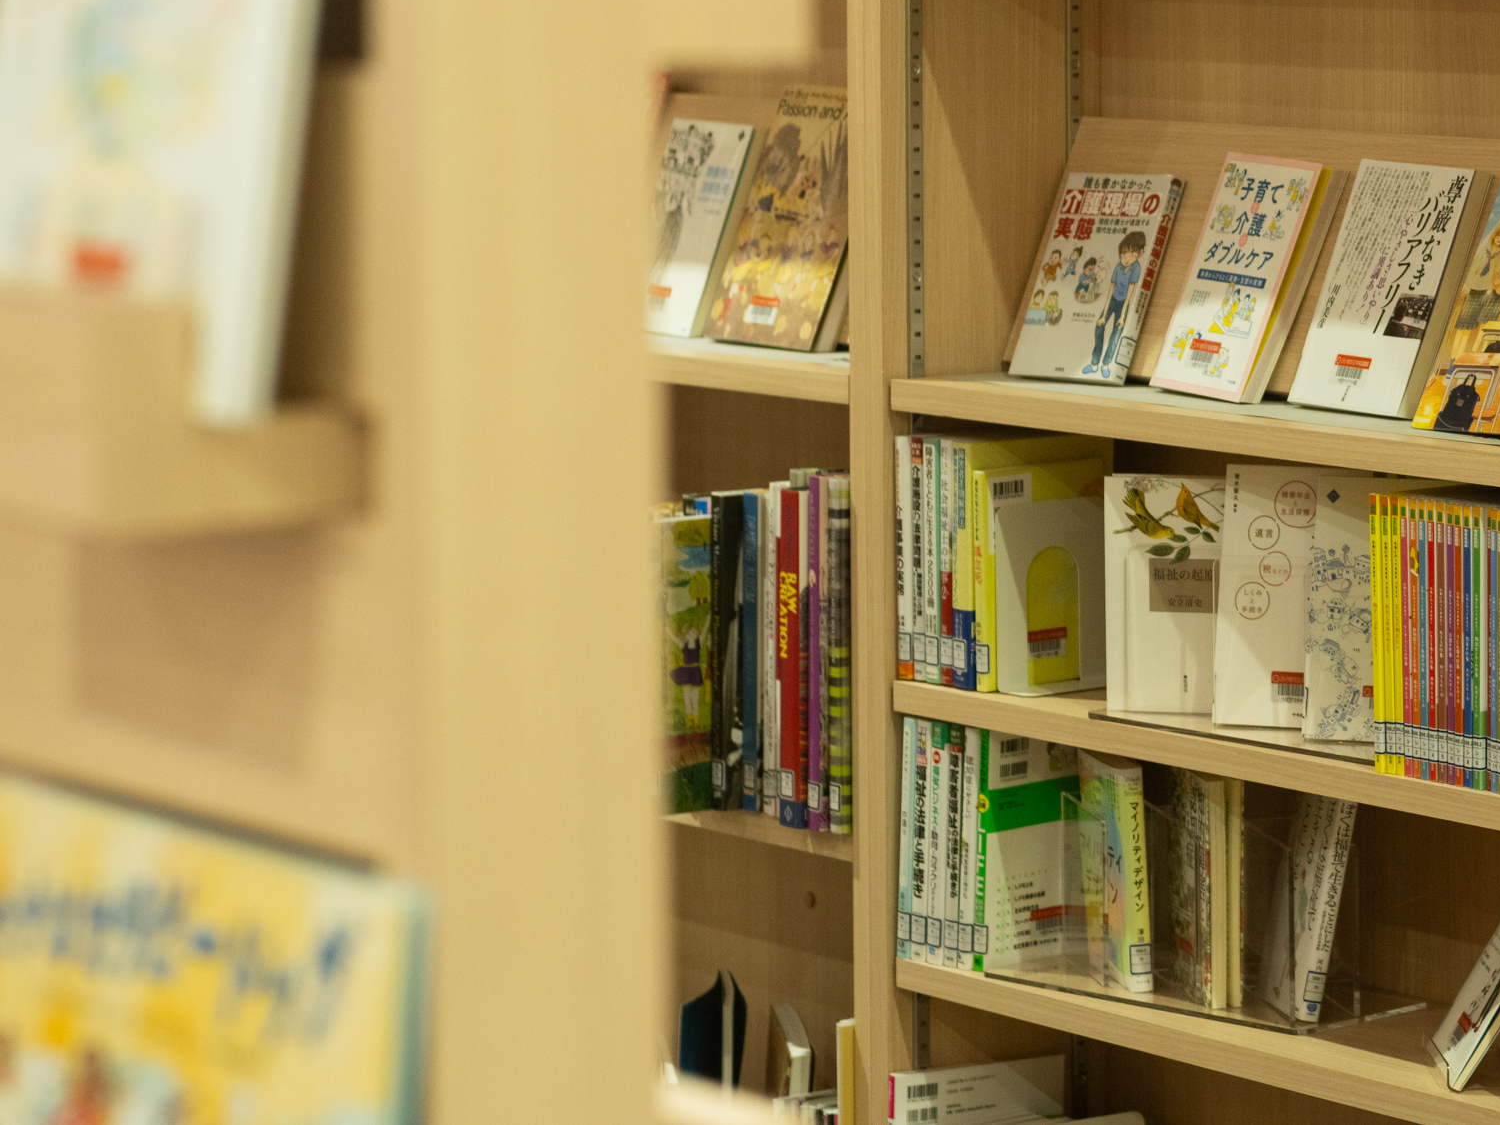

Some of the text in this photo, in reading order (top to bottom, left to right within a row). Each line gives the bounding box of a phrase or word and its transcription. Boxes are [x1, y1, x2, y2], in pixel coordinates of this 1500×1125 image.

[777, 99, 842, 119] Passion and
[1083, 176, 1152, 191] 誰も書かなかった
[1241, 178, 1285, 205] 子育て
[1061, 189, 1161, 217] 介護現場の
[1053, 217, 1096, 241] 実態
[1232, 211, 1267, 237] 介護
[1408, 175, 1468, 291] 尊厳なき
[1203, 240, 1274, 271] ダブルケア
[1372, 190, 1445, 334] バリアフリー
[1254, 528, 1273, 539] 遺言
[787, 572, 798, 615] RAW
[1243, 589, 1262, 597] しくみ
[779, 571, 789, 659] CREATION
[1129, 801, 1146, 913] マイノリティデザイン
